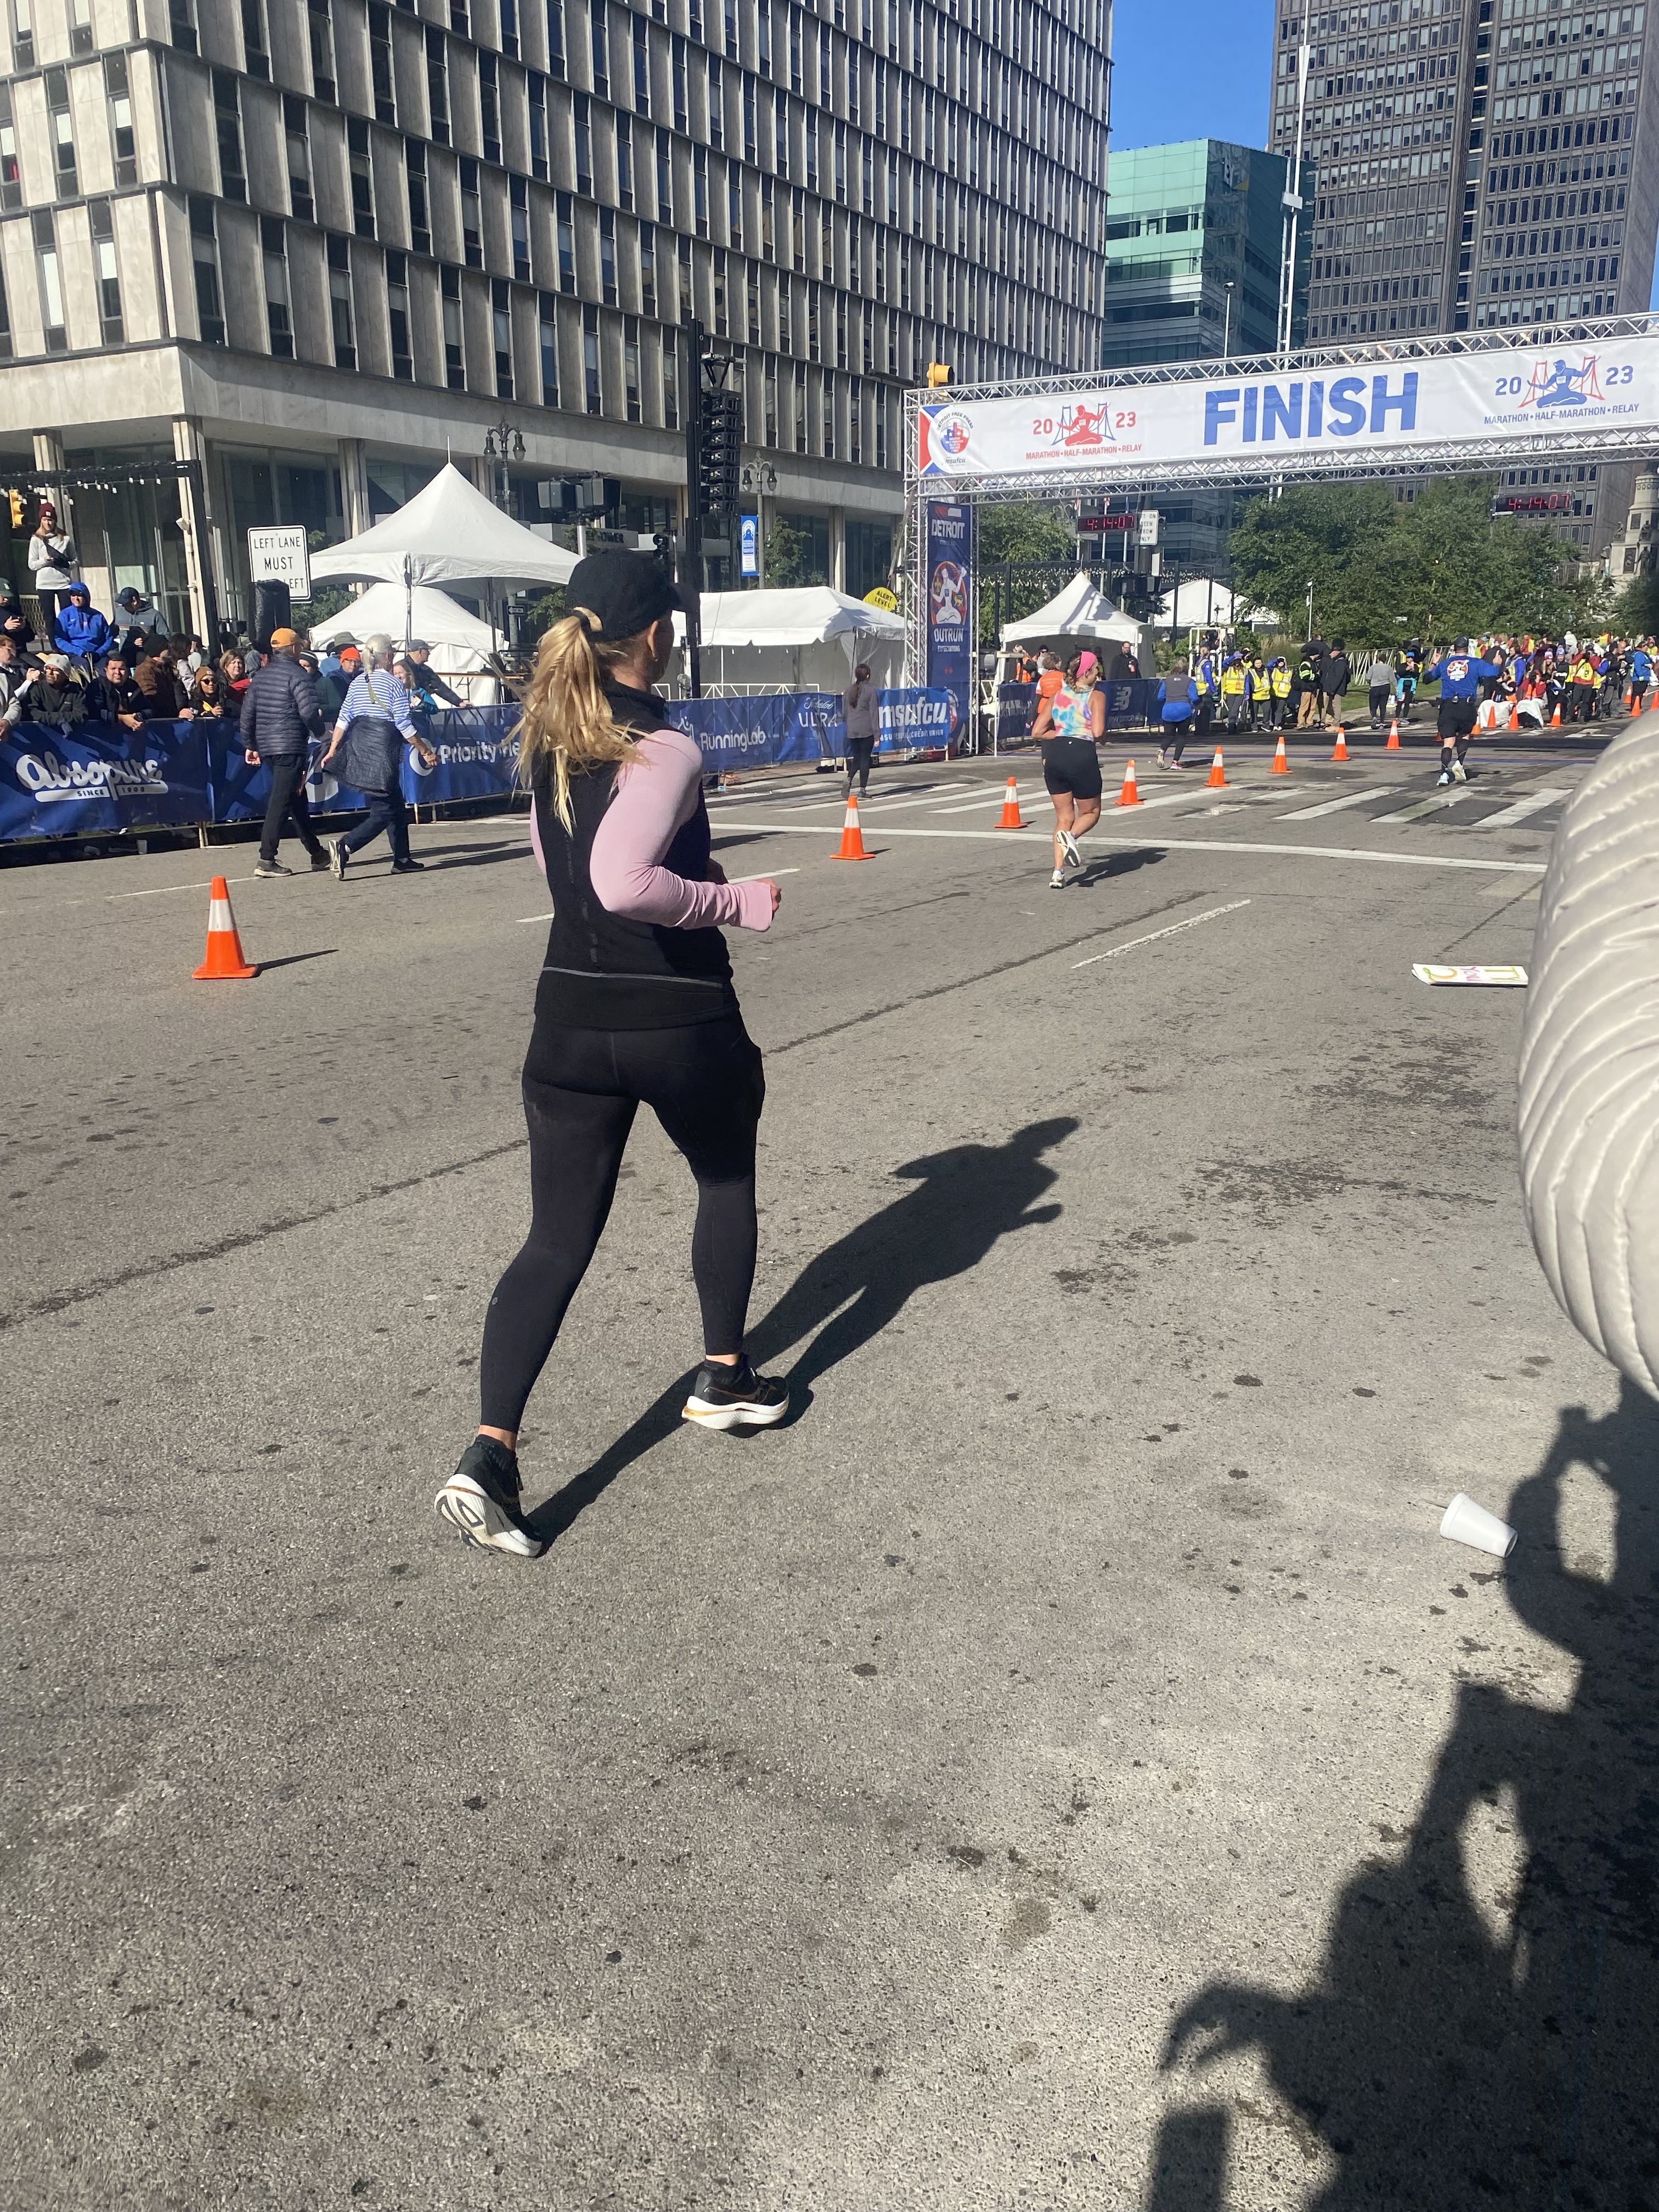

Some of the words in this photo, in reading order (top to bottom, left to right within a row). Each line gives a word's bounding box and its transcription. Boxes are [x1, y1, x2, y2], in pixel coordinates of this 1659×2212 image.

[1204, 372, 1418, 445] FINISH
[1484, 413, 1528, 424] MARATHON
[1535, 407, 1606, 421] HALF-MARATHON
[1612, 404, 1639, 414] RELAY
[1026, 450, 1060, 460] MARATHON
[1064, 446, 1117, 457] HALF-MARATHON
[1122, 444, 1142, 453] RELAY
[932, 519, 965, 539] DETROIT
[254, 538, 274, 549] LEFT
[279, 537, 301, 548] LANE
[601, 531, 624, 544] OWER
[264, 556, 293, 570] MUST
[874, 596, 890, 608] LEVEL
[877, 590, 893, 601] ALERT
[934, 628, 964, 642] OUTRUN
[798, 712, 838, 727] ULTRA
[700, 726, 766, 752] RunningLab
[911, 730, 928, 738] CREDIT
[440, 741, 496, 764] Priority
[77, 789, 104, 797] SINCE
